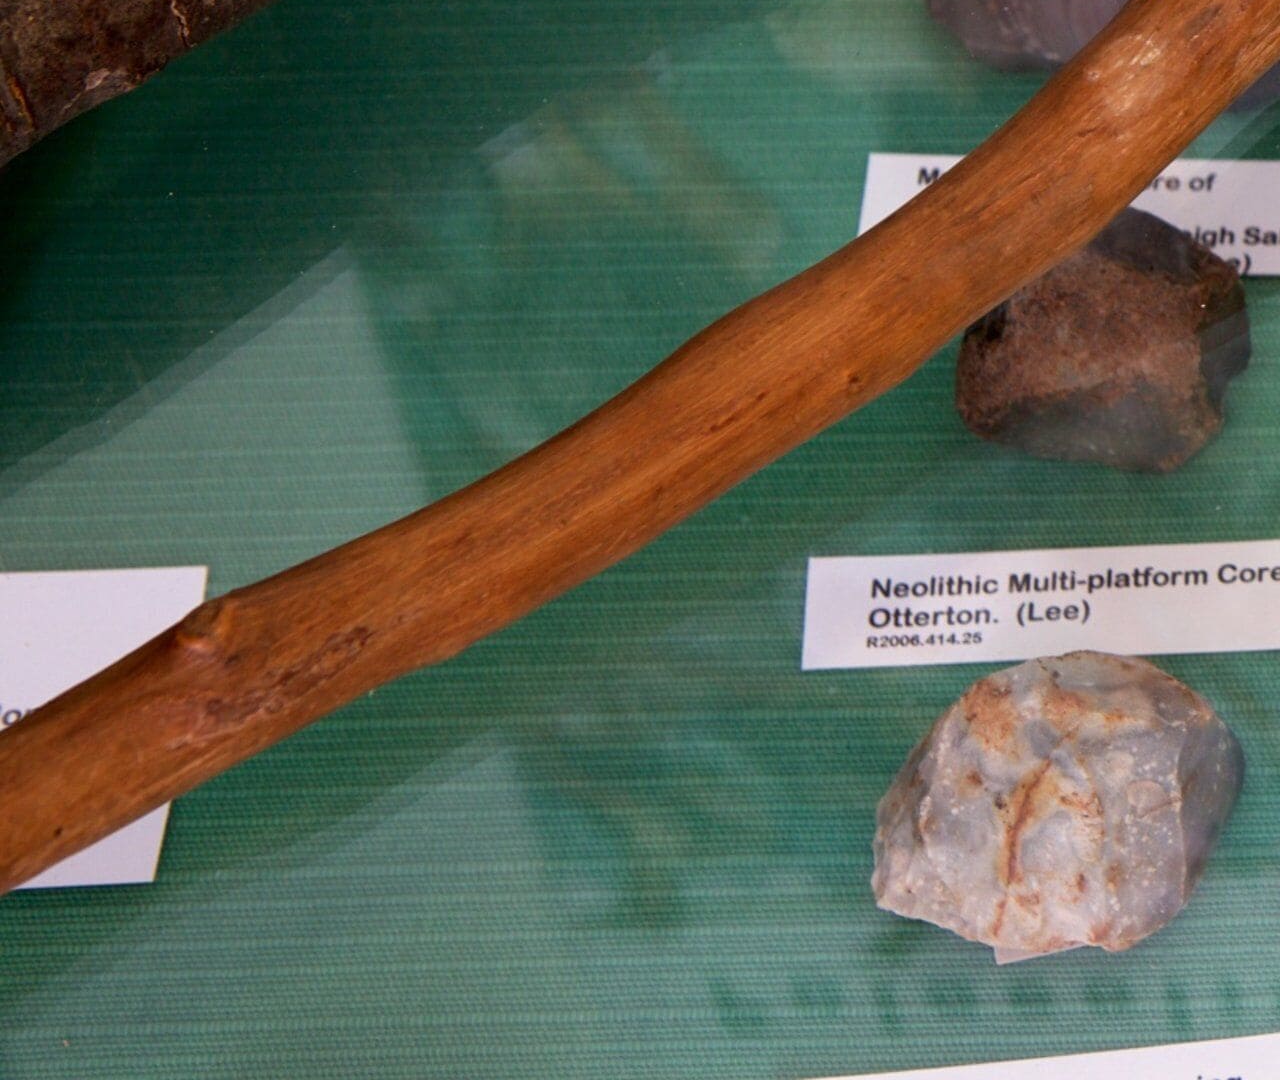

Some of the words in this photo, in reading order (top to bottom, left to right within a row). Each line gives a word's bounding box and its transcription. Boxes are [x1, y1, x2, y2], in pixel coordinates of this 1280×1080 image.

[1188, 173, 1216, 192] of
[871, 575, 998, 599] Neolithic
[1009, 567, 1208, 594] Multi-platform
[868, 606, 998, 629] Otterton.
[1017, 600, 1090, 627] (Lee)
[866, 632, 982, 648] R2006.414.25
